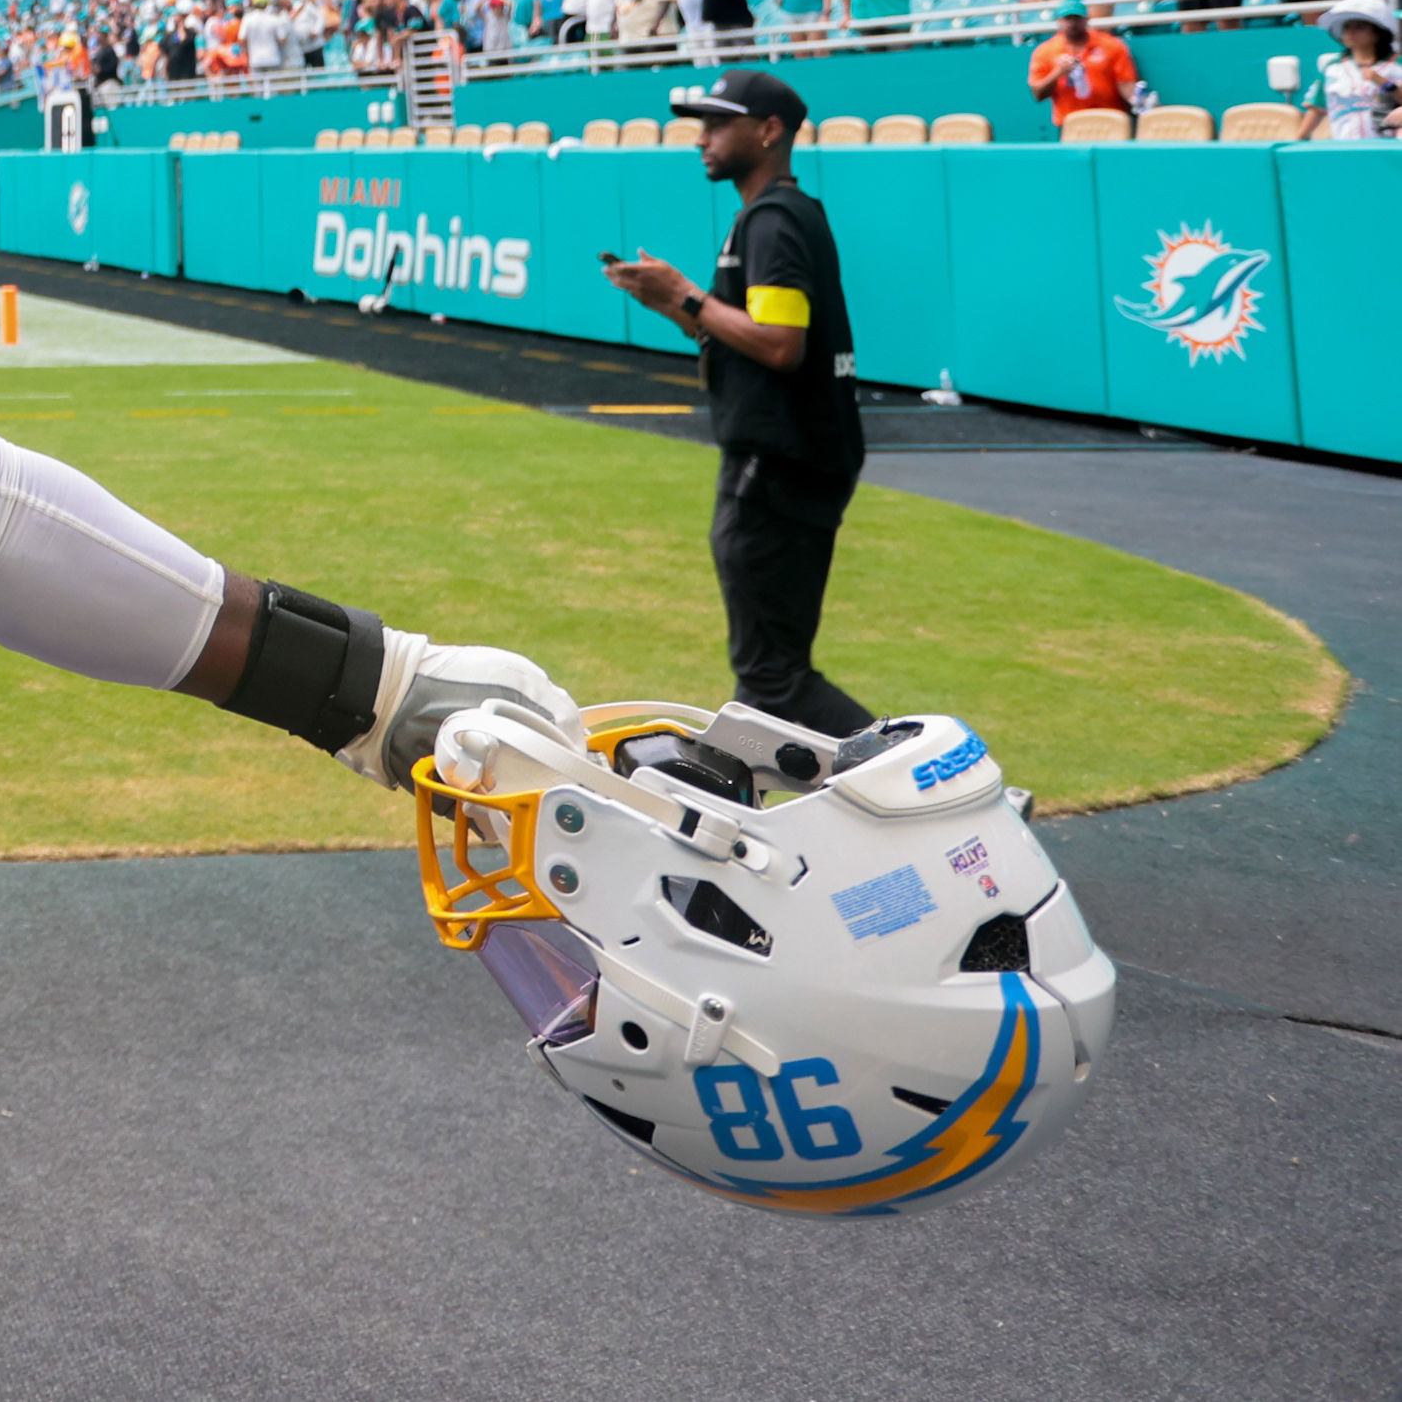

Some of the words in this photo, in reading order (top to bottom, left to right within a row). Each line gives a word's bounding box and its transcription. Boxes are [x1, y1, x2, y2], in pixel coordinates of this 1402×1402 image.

[320, 177, 401, 208] MIAMI
[312, 210, 532, 300] Dolphins
[949, 842, 989, 875] CATCH
